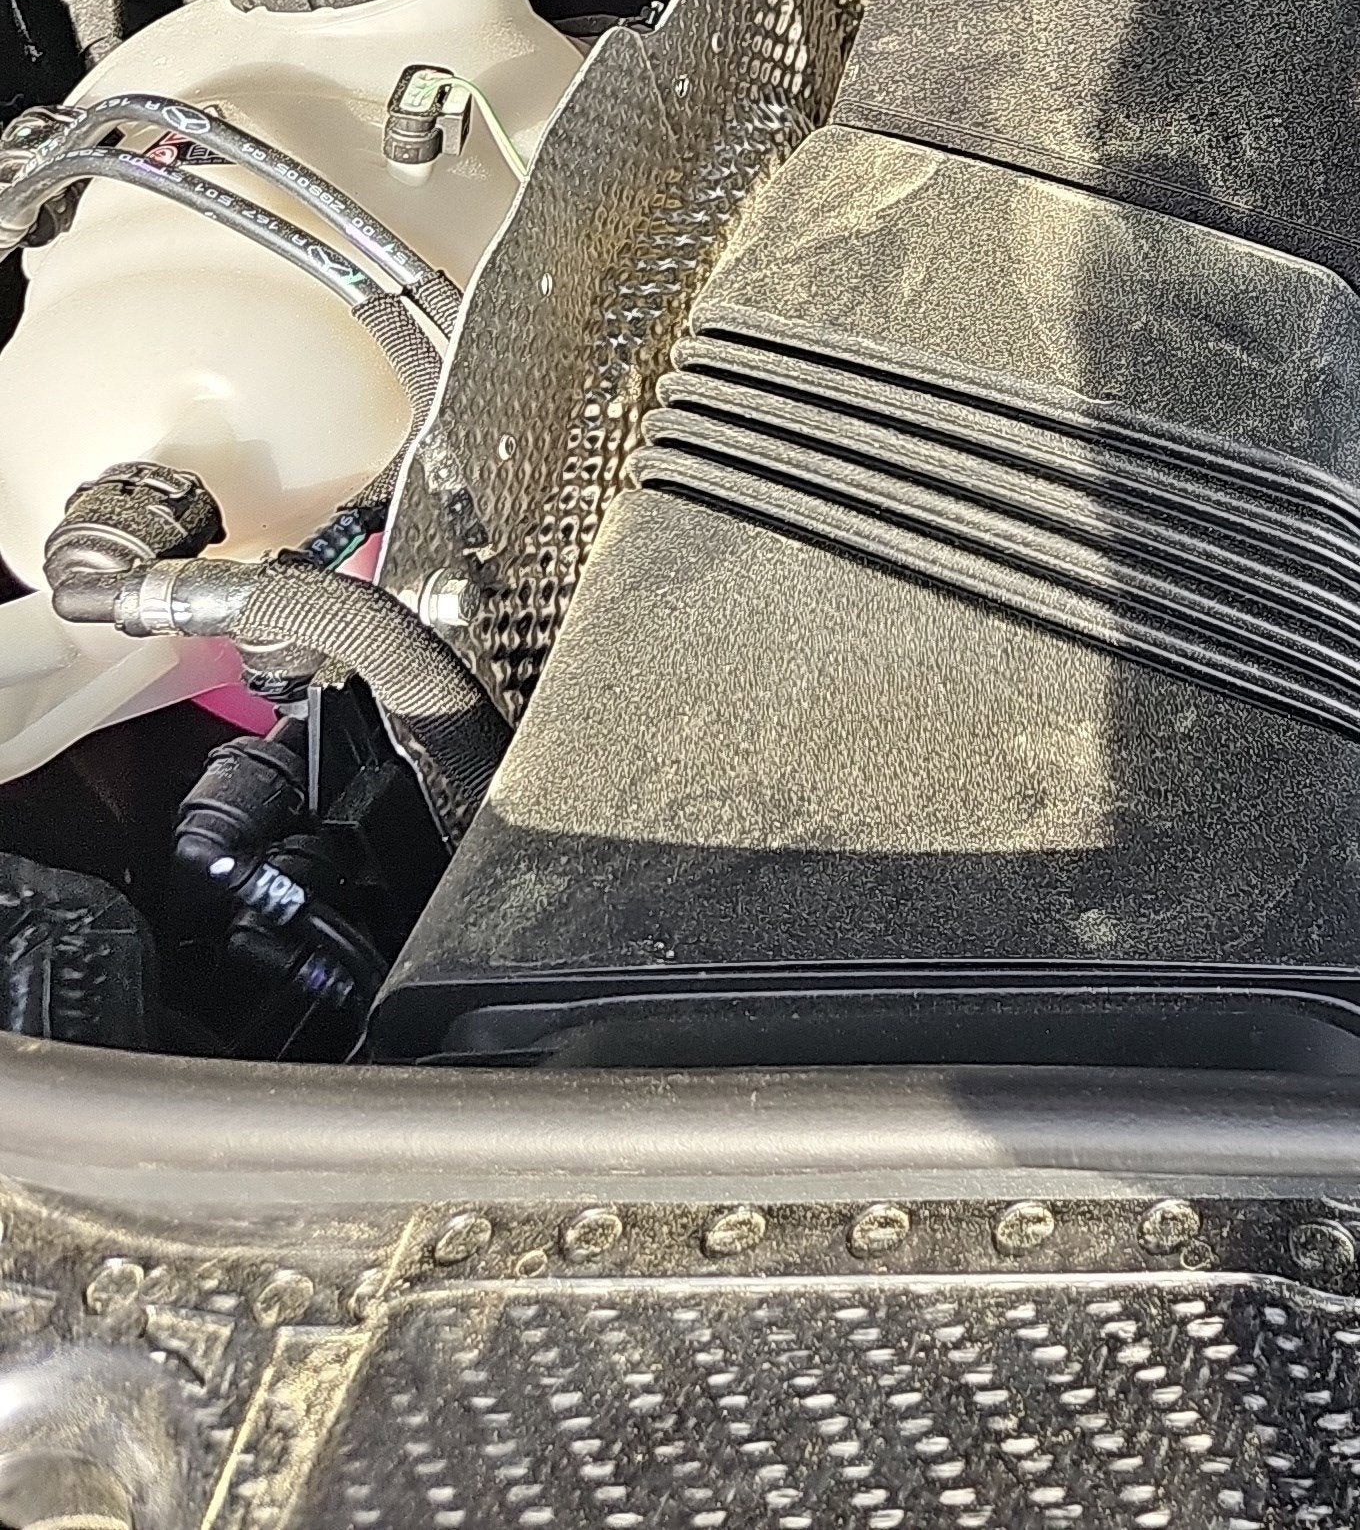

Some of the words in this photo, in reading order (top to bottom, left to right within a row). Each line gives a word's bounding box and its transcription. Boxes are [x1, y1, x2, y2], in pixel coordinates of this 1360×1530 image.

[194, 182, 236, 207] 501
[241, 209, 281, 231] 167
[291, 234, 307, 246] A
